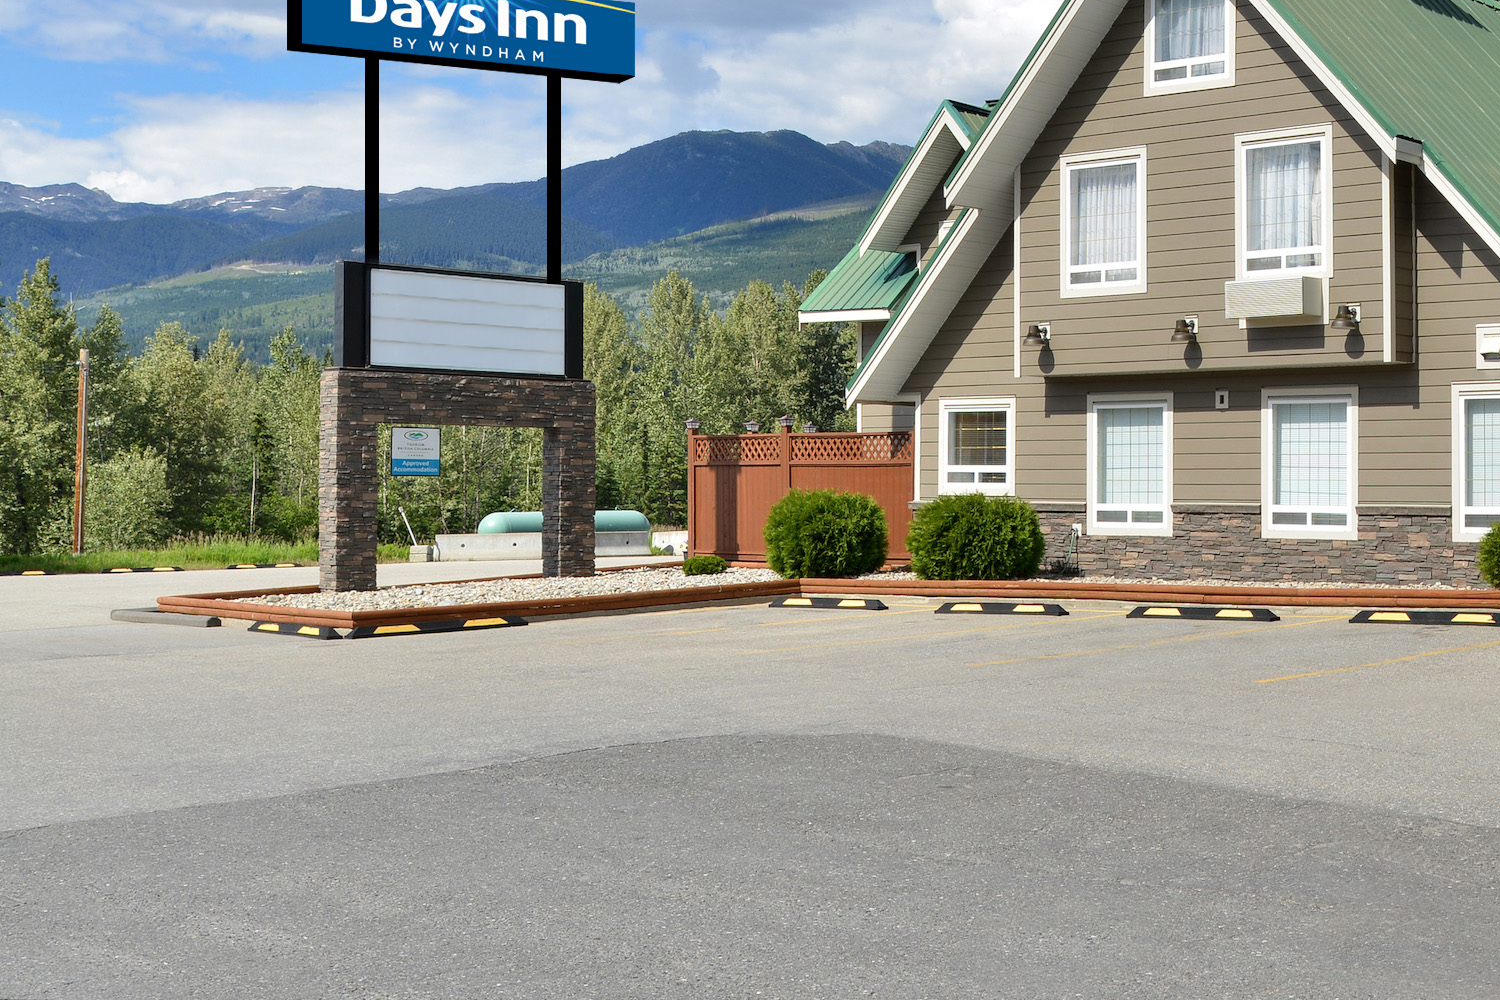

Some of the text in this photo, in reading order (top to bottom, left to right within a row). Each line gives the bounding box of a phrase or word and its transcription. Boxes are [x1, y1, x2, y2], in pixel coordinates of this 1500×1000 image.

[498, 0, 587, 45] Inn
[393, 36, 544, 63] BY WYNDHAM
